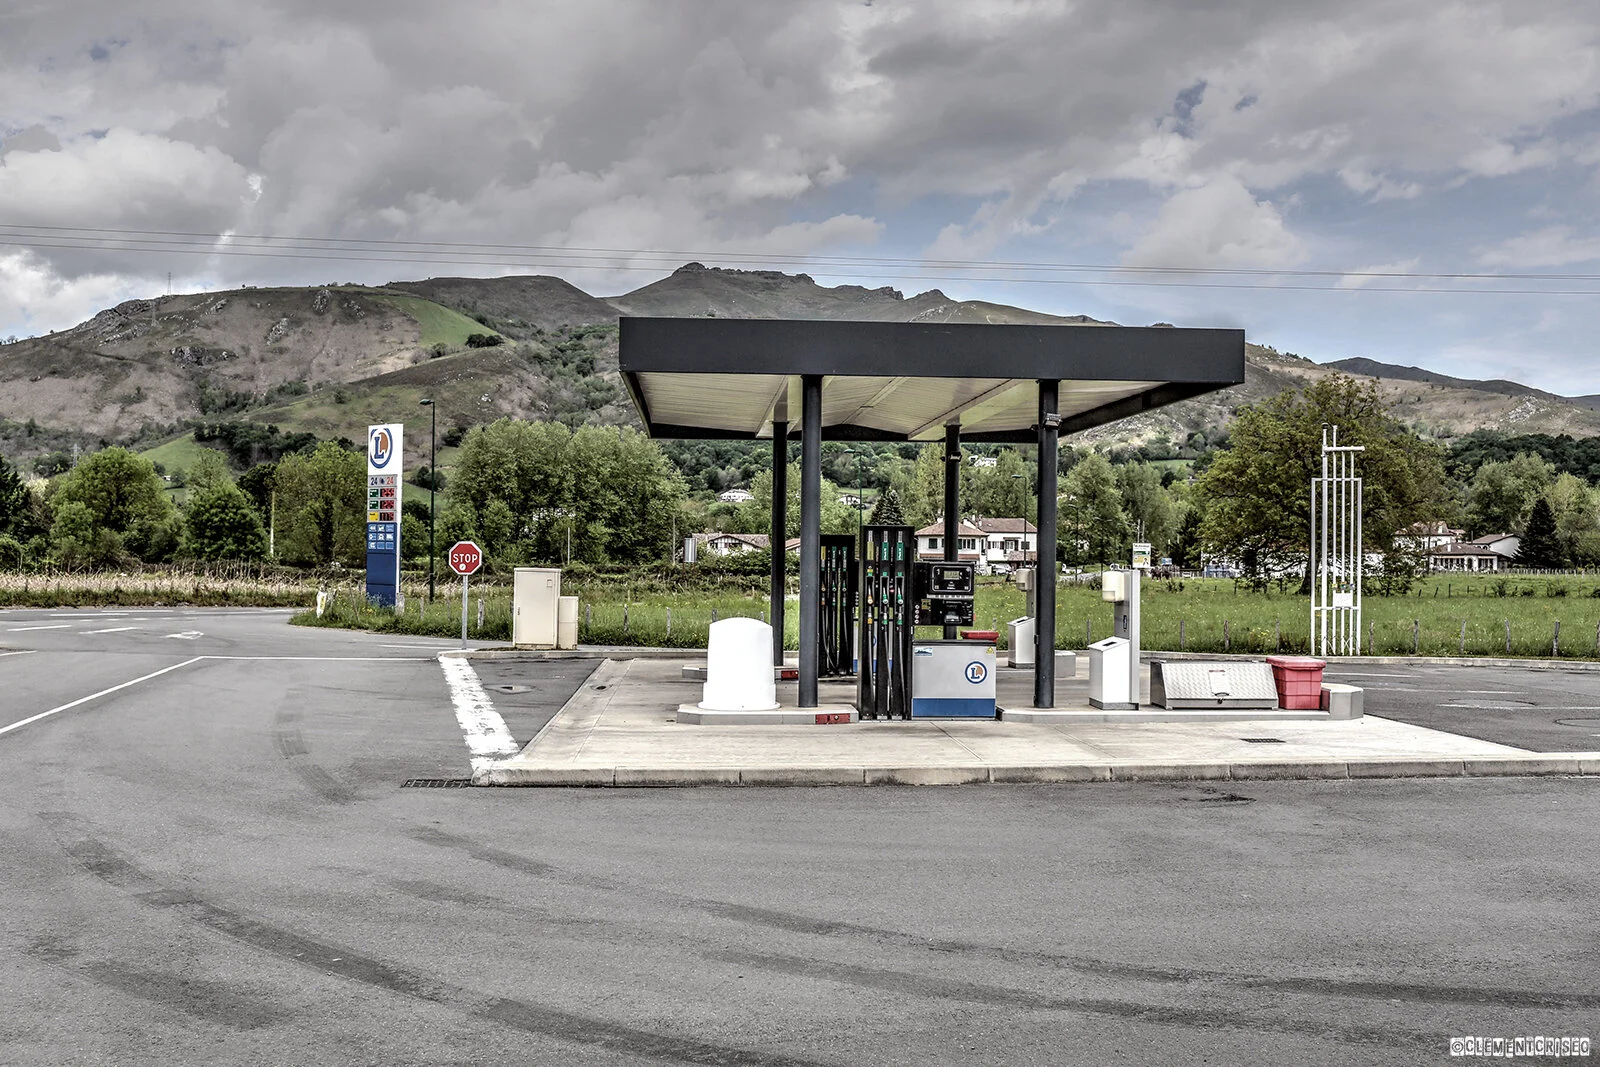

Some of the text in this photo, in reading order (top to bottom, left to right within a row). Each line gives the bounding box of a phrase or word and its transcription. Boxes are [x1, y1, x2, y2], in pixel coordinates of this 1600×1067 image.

[370, 476, 394, 486] 24 24
[452, 553, 478, 563] STOP
